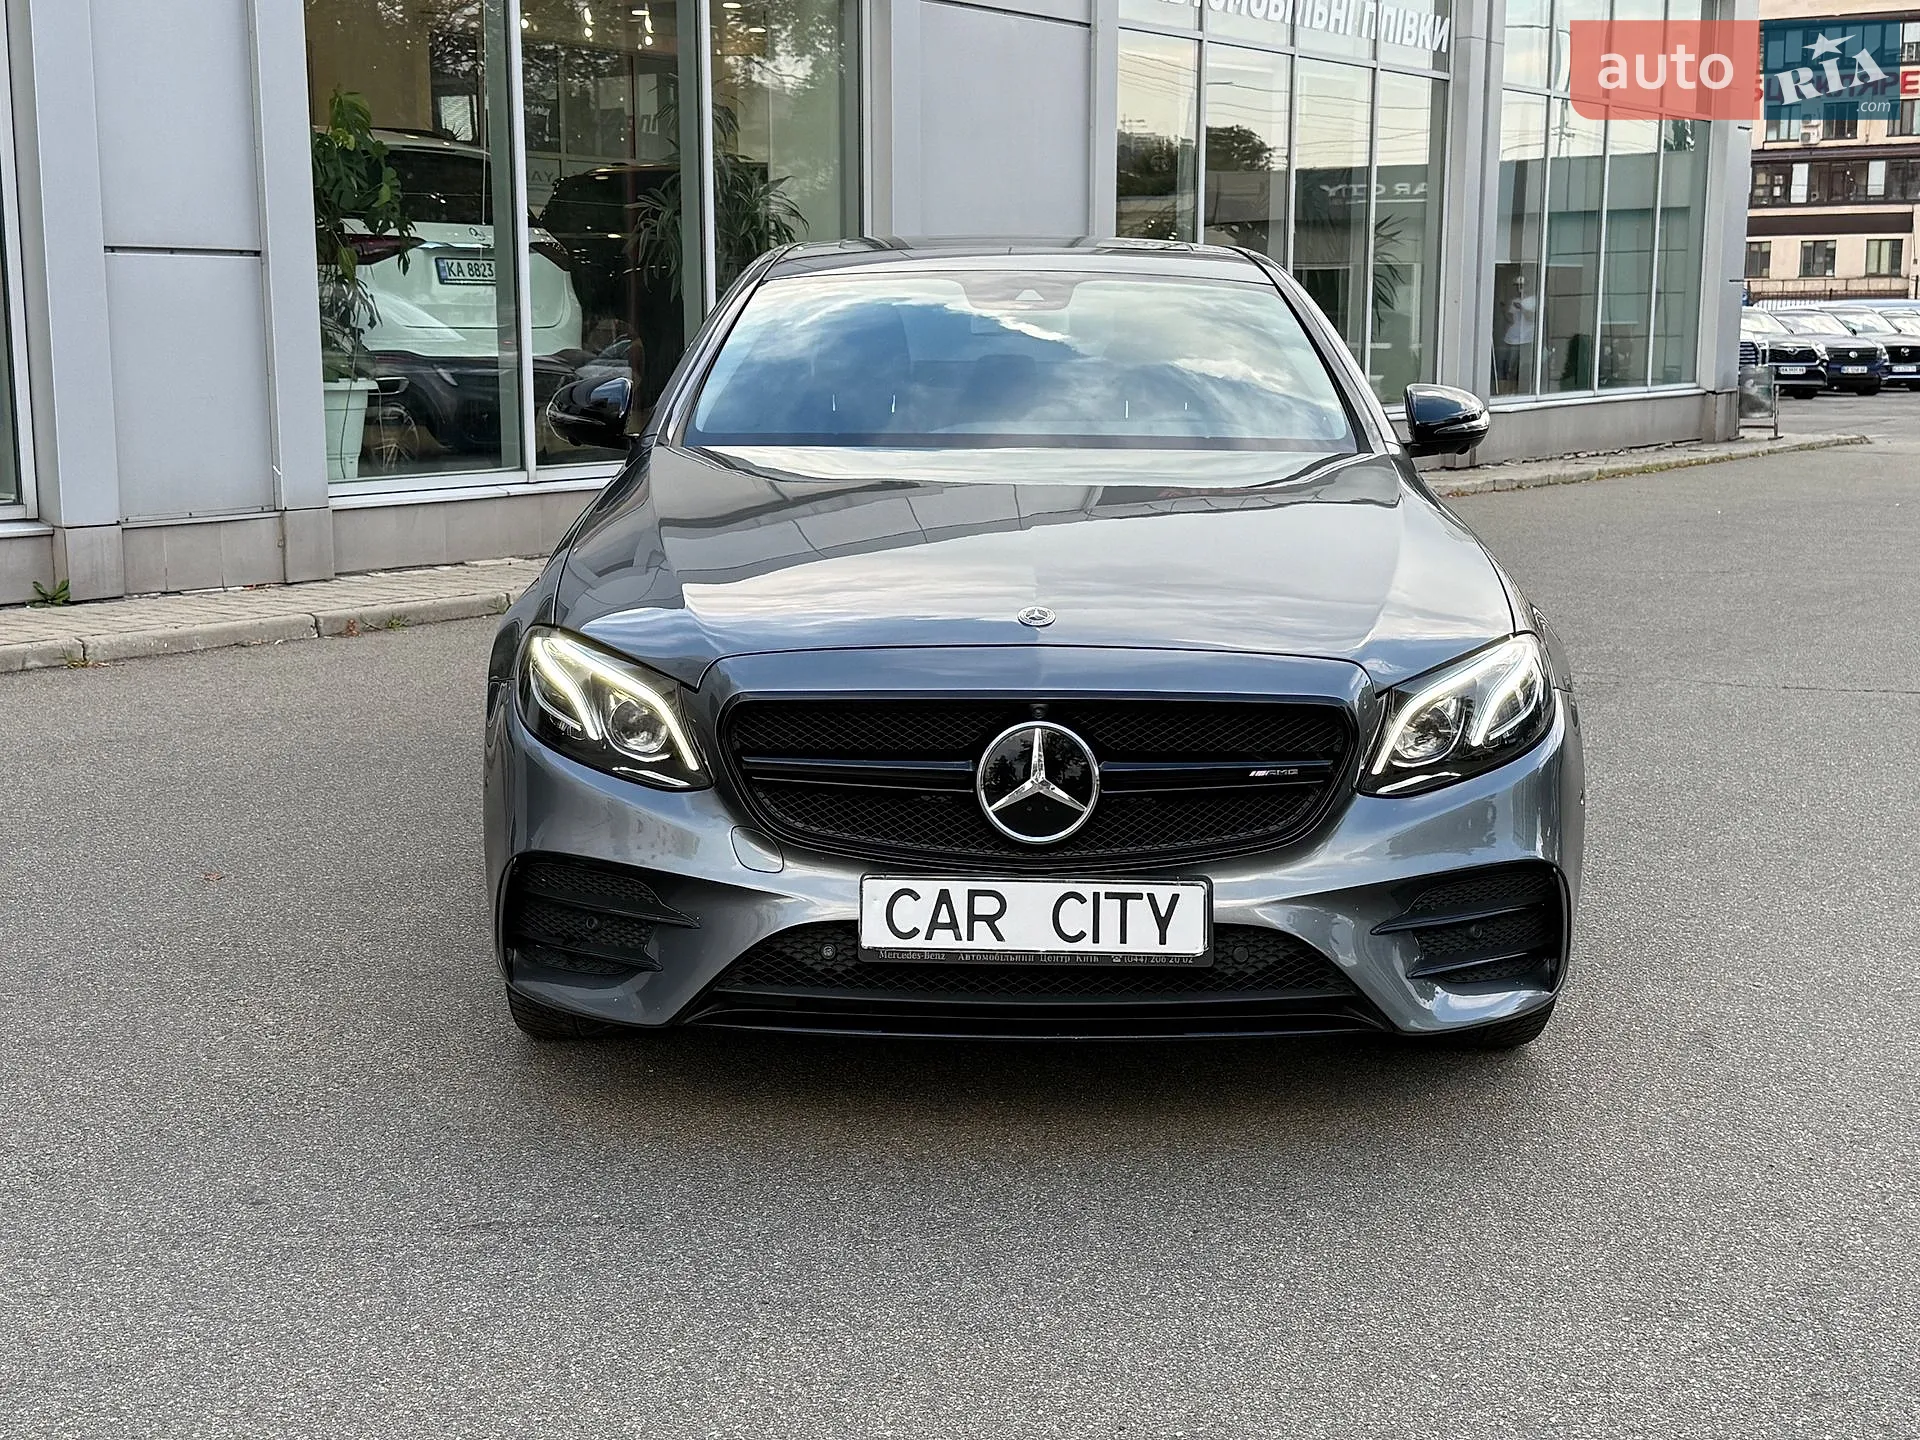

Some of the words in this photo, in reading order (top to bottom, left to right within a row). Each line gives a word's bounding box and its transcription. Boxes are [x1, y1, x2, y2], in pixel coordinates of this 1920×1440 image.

[1361, 1, 1450, 53] ПЛІВКИ
[446, 261, 466, 278] KA
[467, 262, 494, 278] 8823
[885, 887, 1007, 943] CAR
[1052, 890, 1180, 946] CITY
[879, 950, 946, 961] Mercedes-Benz
